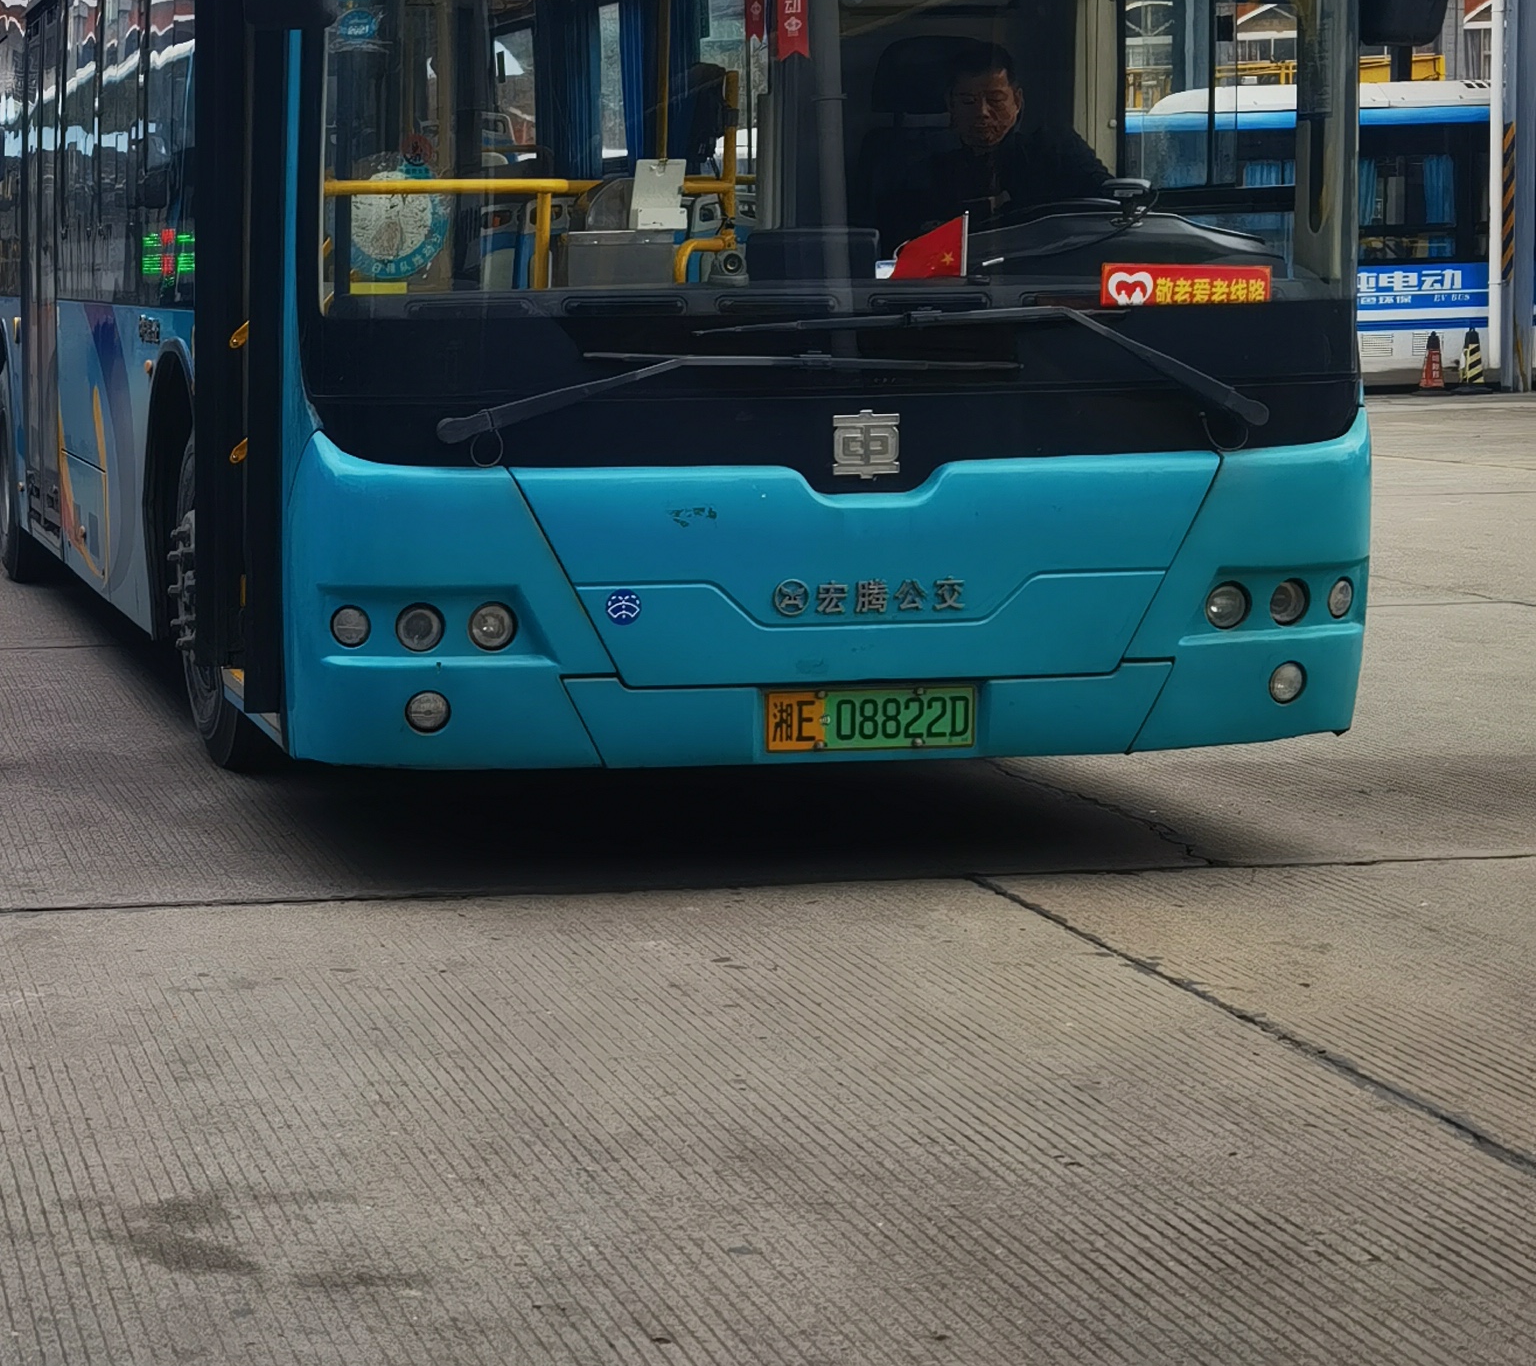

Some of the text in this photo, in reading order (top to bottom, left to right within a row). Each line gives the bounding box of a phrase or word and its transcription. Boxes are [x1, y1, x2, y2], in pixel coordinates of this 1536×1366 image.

[1155, 276, 1266, 305] 敬老爱老线路
[816, 574, 966, 614] 宏腾公交
